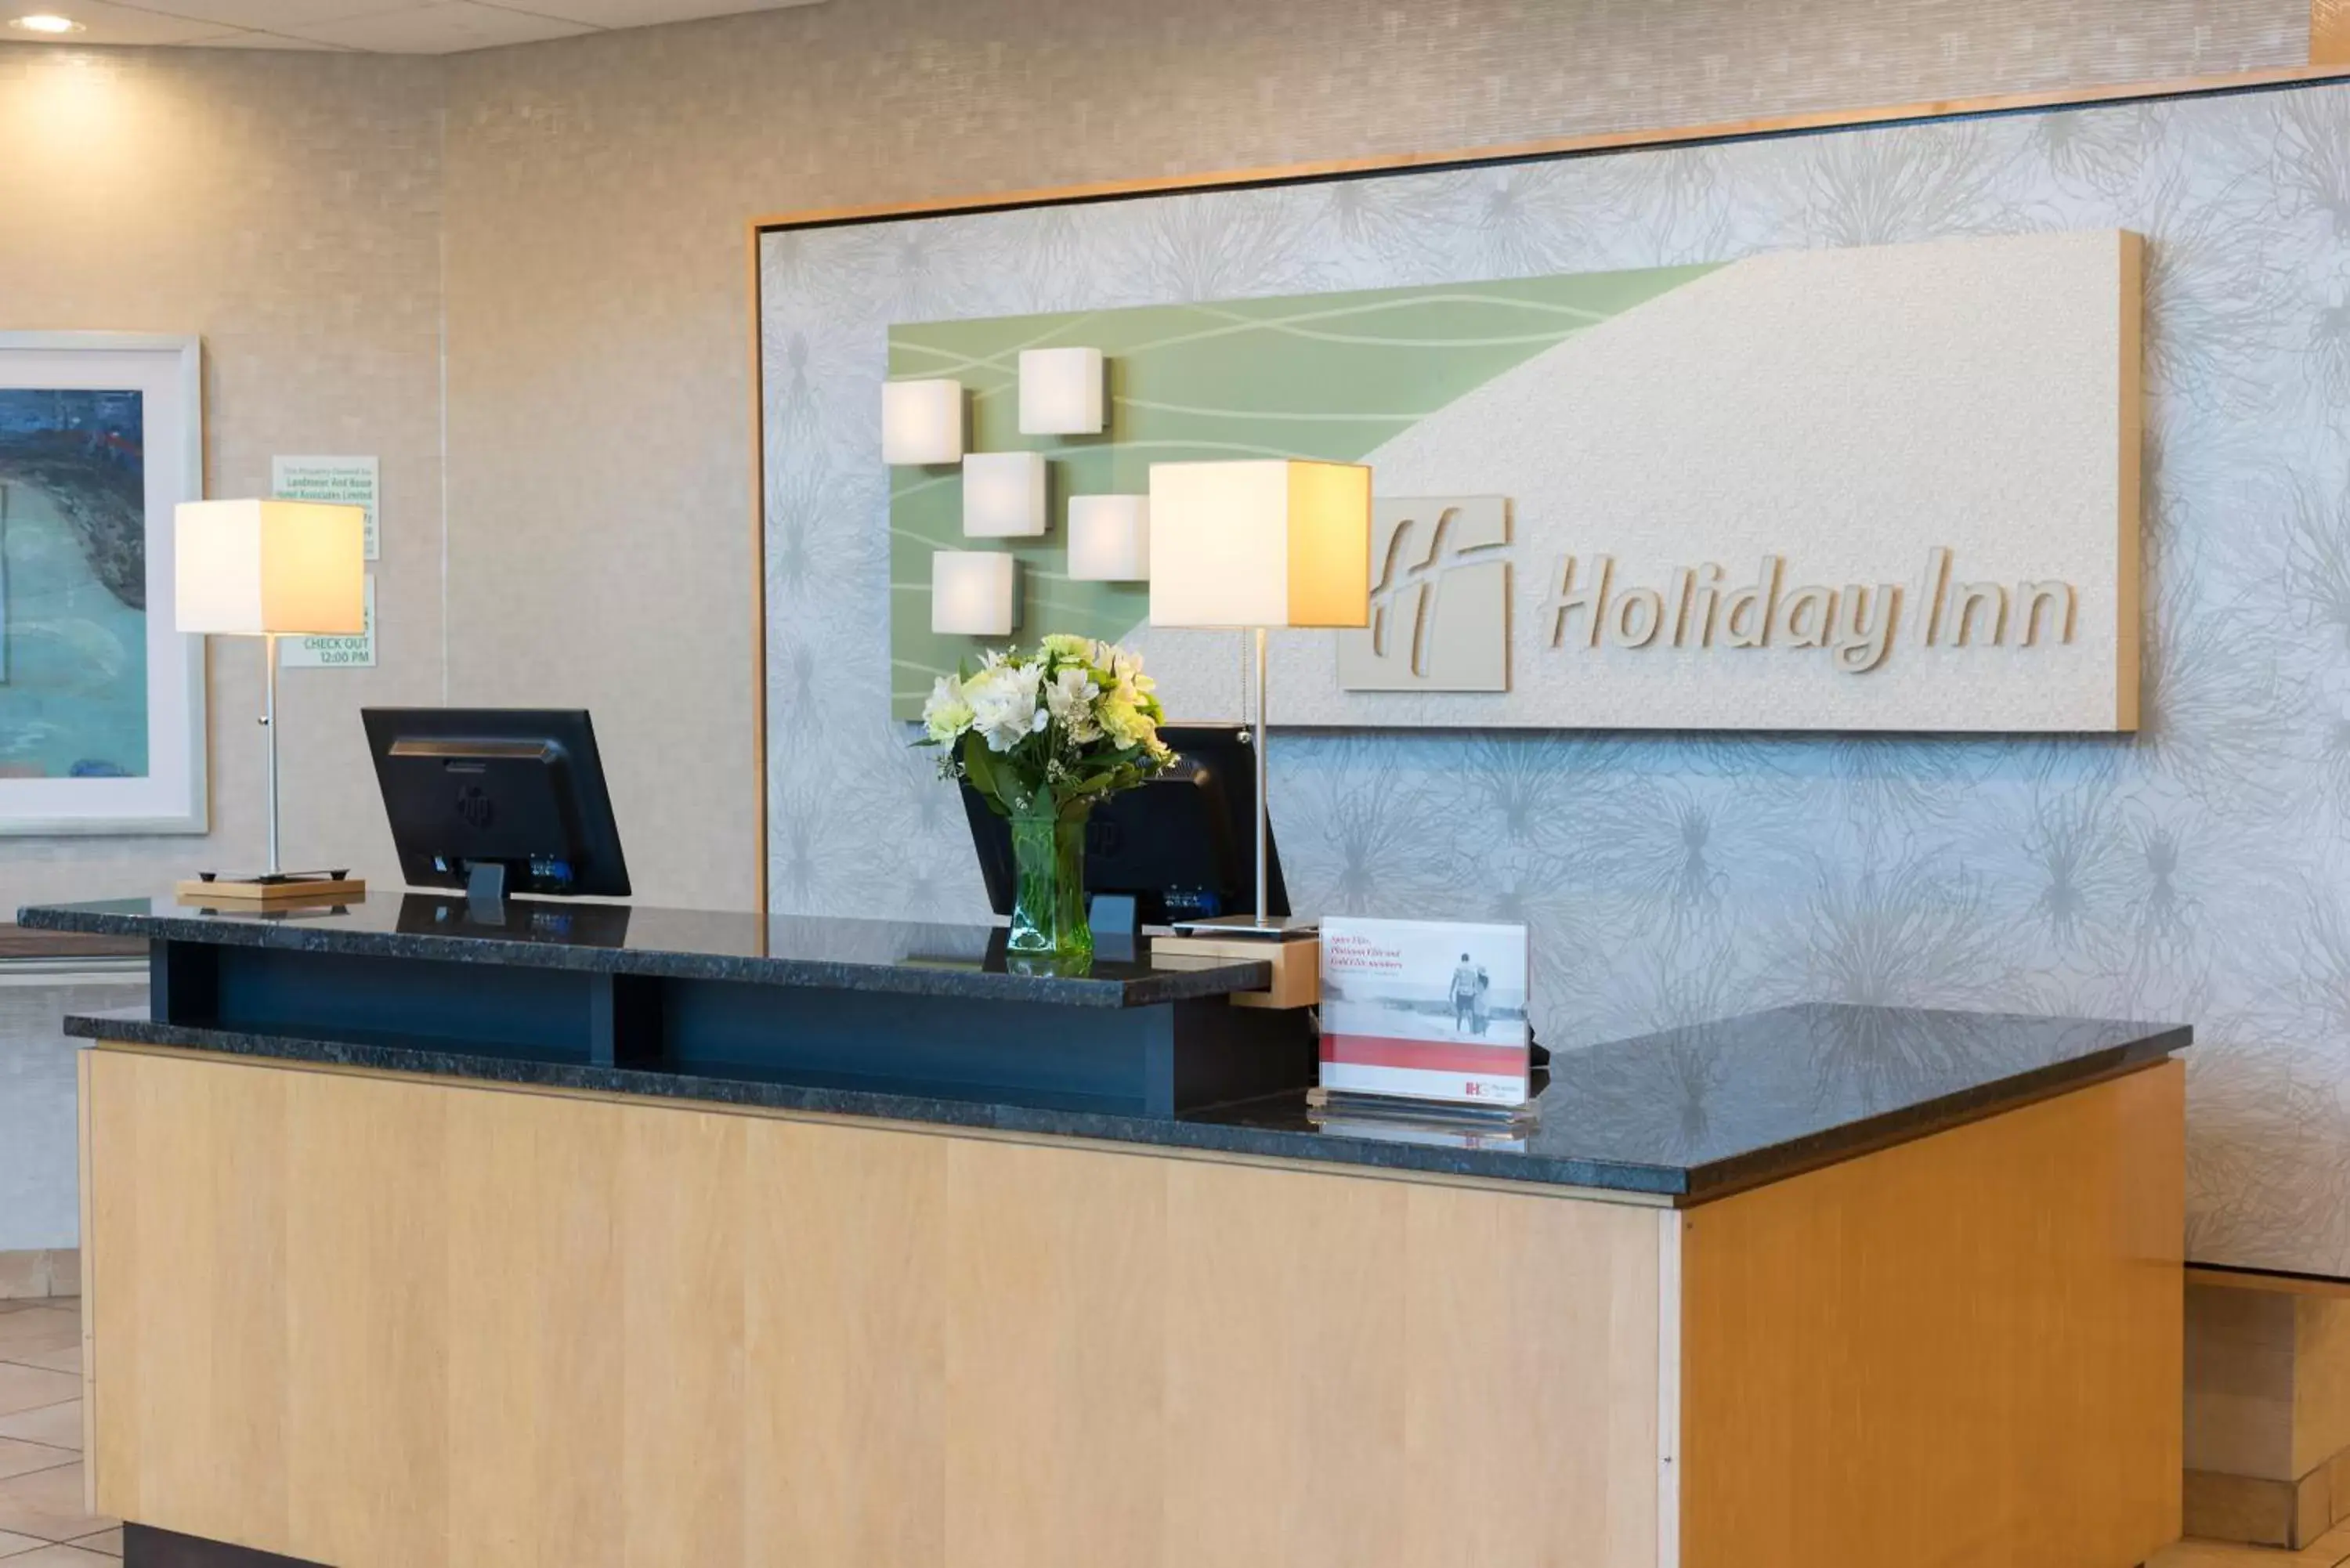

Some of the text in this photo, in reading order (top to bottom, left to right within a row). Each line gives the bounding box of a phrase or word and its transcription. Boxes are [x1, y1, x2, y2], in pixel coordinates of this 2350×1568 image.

[1542, 553, 1904, 674] Holiday
[1912, 545, 2081, 648] Inn
[304, 638, 368, 649] CHECK OUT
[320, 651, 369, 663] 12:00 PM
